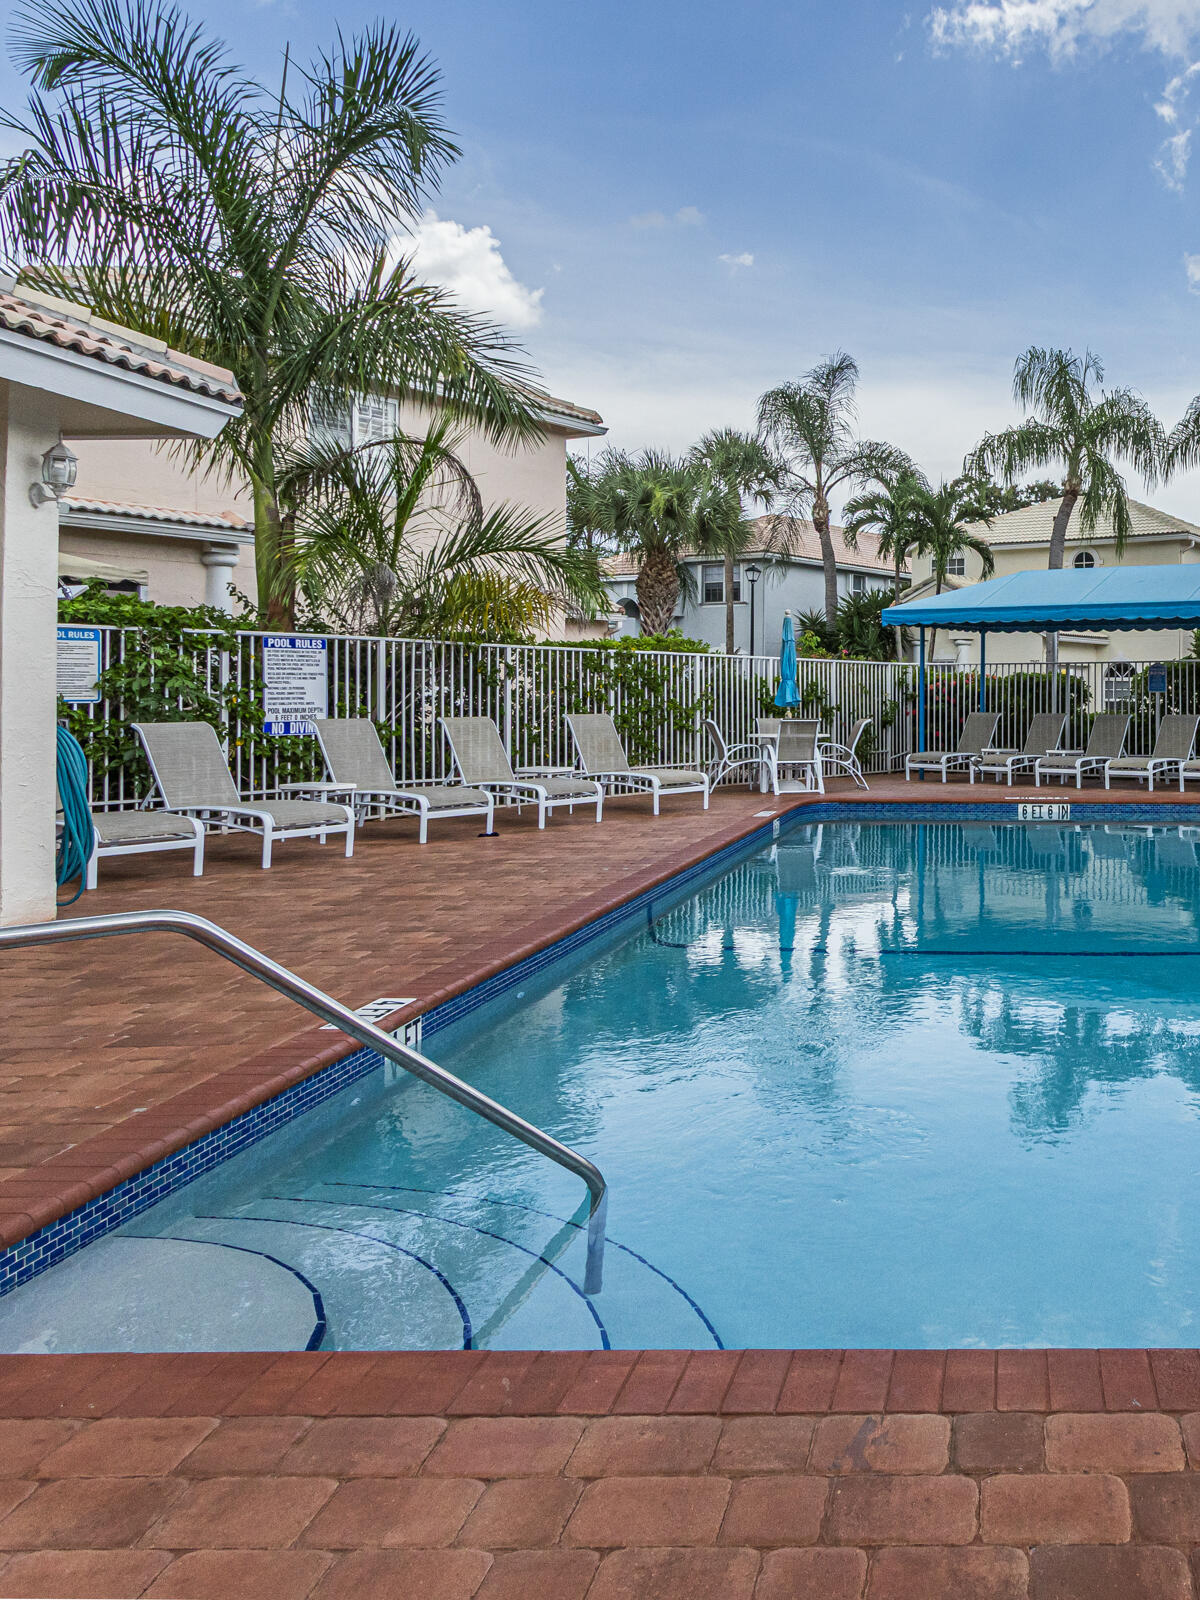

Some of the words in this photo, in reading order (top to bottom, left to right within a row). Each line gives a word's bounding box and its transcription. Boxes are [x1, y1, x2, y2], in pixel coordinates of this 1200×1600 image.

[68, 631, 95, 639] RULES
[267, 638, 292, 648] POOL
[295, 639, 323, 649] RULES
[271, 722, 285, 735] NO
[290, 722, 317, 734] DIVIN
